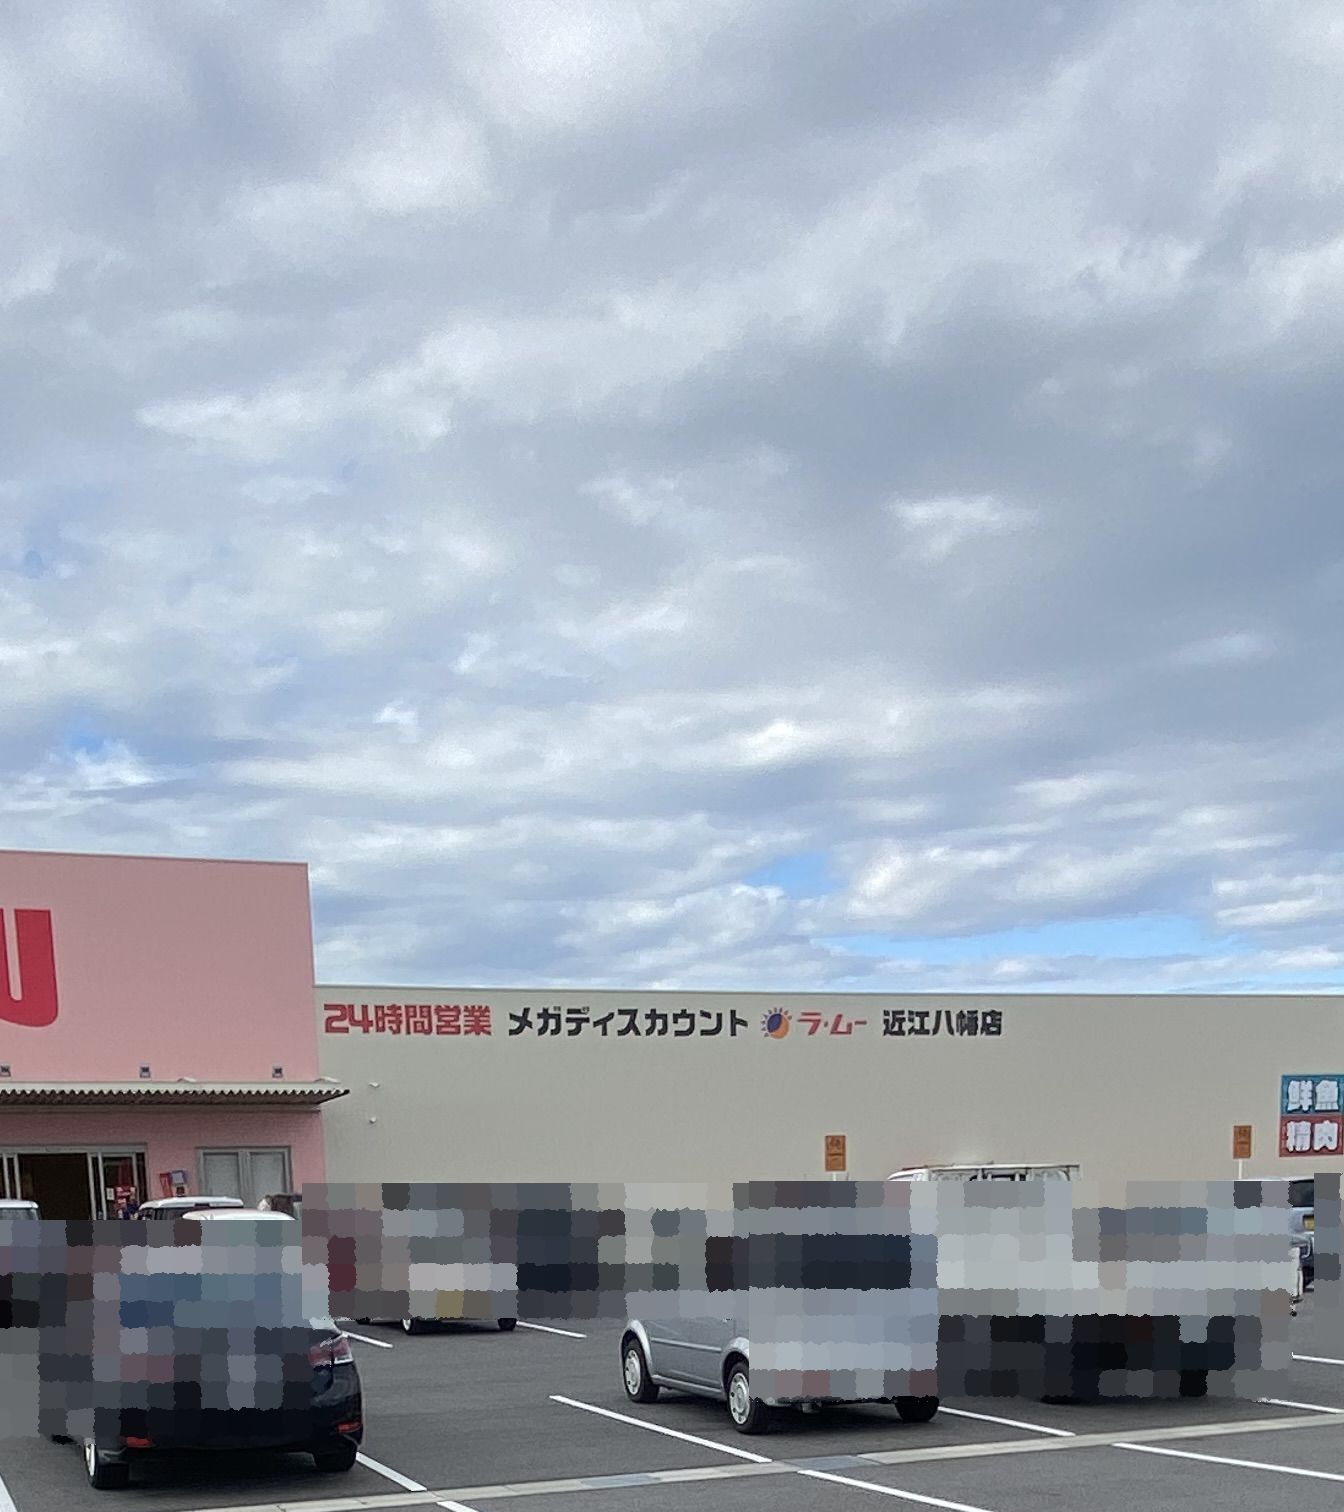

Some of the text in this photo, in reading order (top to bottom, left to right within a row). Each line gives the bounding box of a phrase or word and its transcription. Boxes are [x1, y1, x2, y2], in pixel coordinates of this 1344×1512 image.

[323, 1003, 492, 1036] 24時間営業
[508, 1007, 749, 1037] メガディスカウント
[882, 1009, 1003, 1037] 近江八幡店
[1287, 1079, 1340, 1112] 鮮魚
[1285, 1119, 1339, 1152] 精肉
